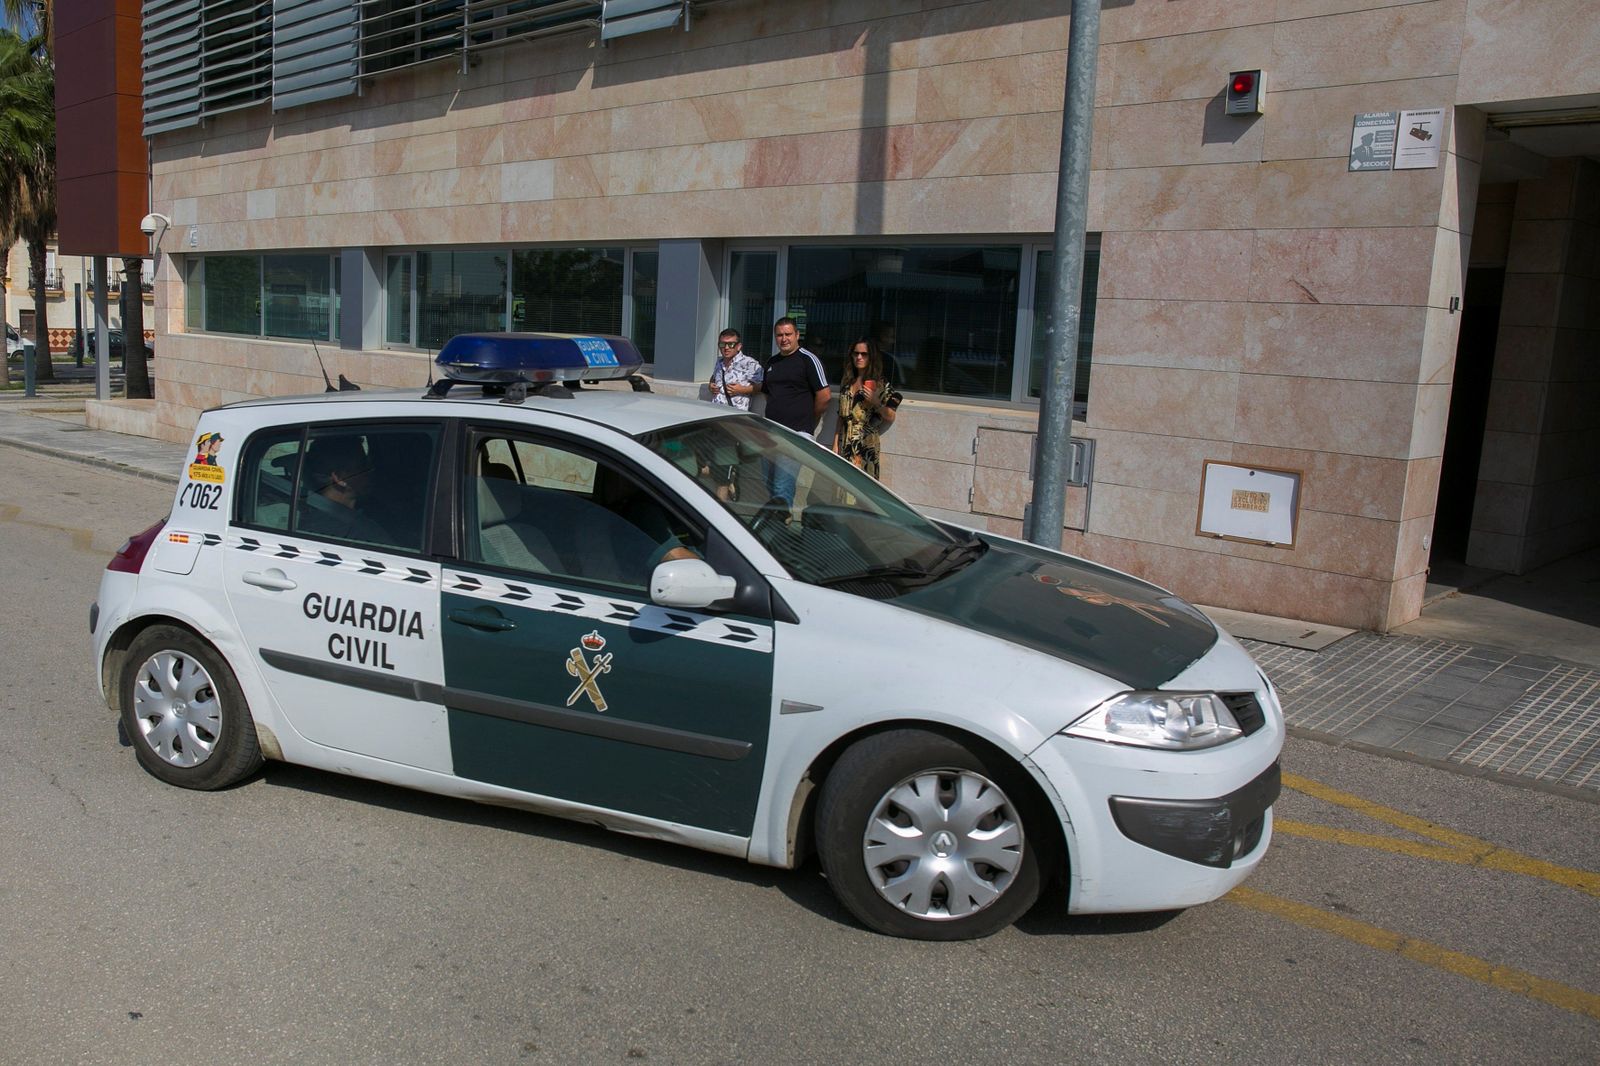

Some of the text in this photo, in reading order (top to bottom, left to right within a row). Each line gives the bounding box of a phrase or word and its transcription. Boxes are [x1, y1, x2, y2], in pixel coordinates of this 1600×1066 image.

[1357, 119, 1395, 127] CONECTADA
[578, 340, 612, 351] GUARDIA
[591, 352, 612, 364] CIVIL
[190, 482, 223, 510] 062
[1233, 502, 1266, 511] BOMBEROS
[303, 592, 424, 640] GUARDIA
[328, 633, 395, 670] CIVIL
